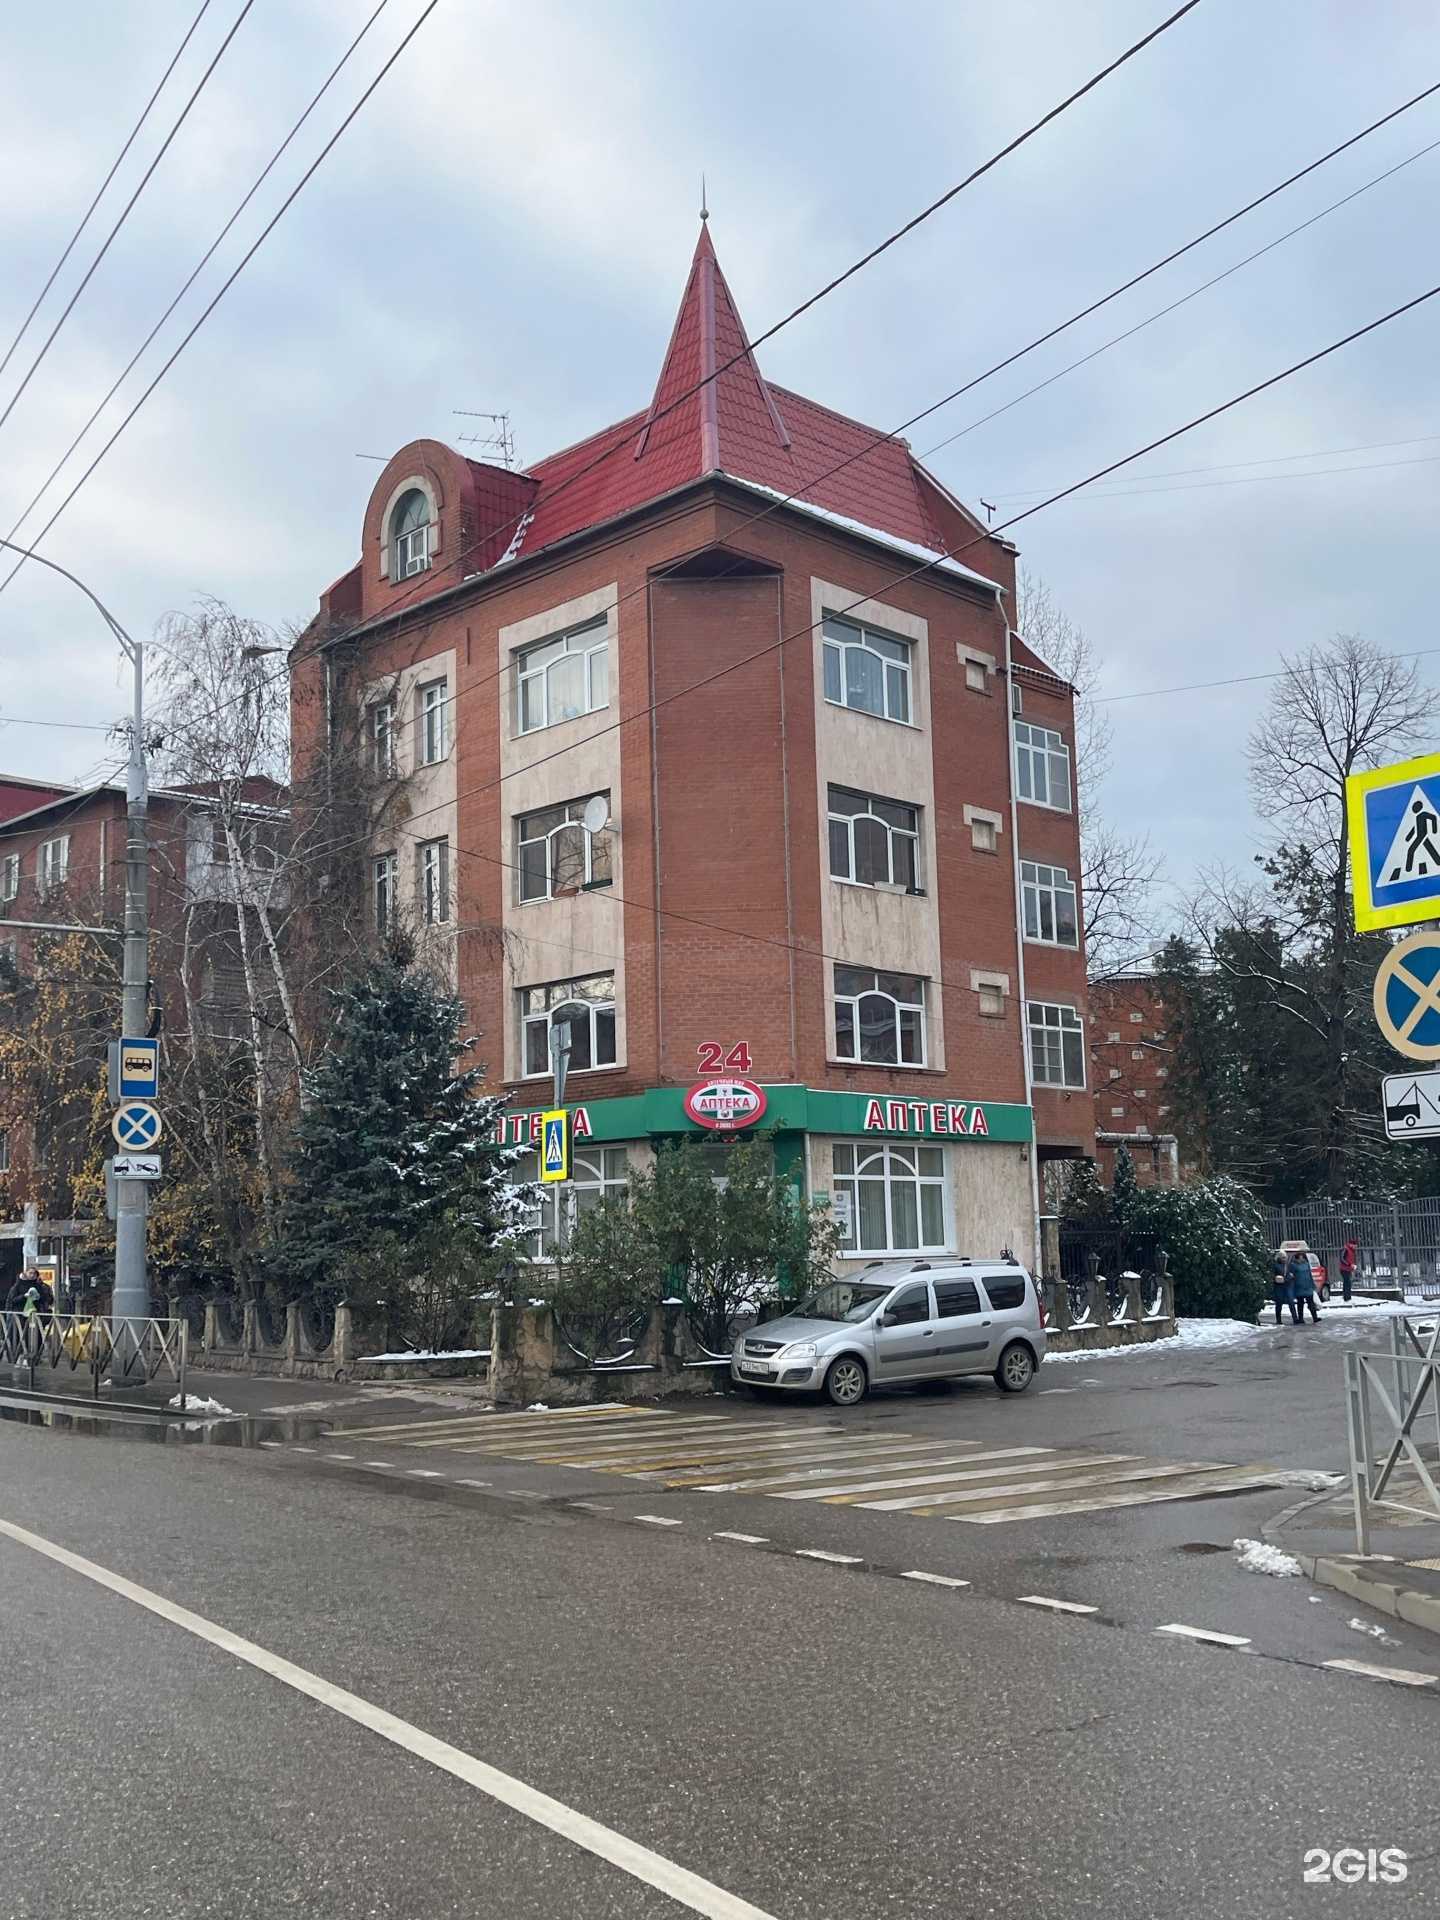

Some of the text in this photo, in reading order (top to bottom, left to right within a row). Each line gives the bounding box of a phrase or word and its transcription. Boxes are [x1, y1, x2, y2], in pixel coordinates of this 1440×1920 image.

[697, 1040, 752, 1073] 24
[700, 1097, 751, 1109] АПТЕКА
[864, 1099, 989, 1136] АПТЕКА
